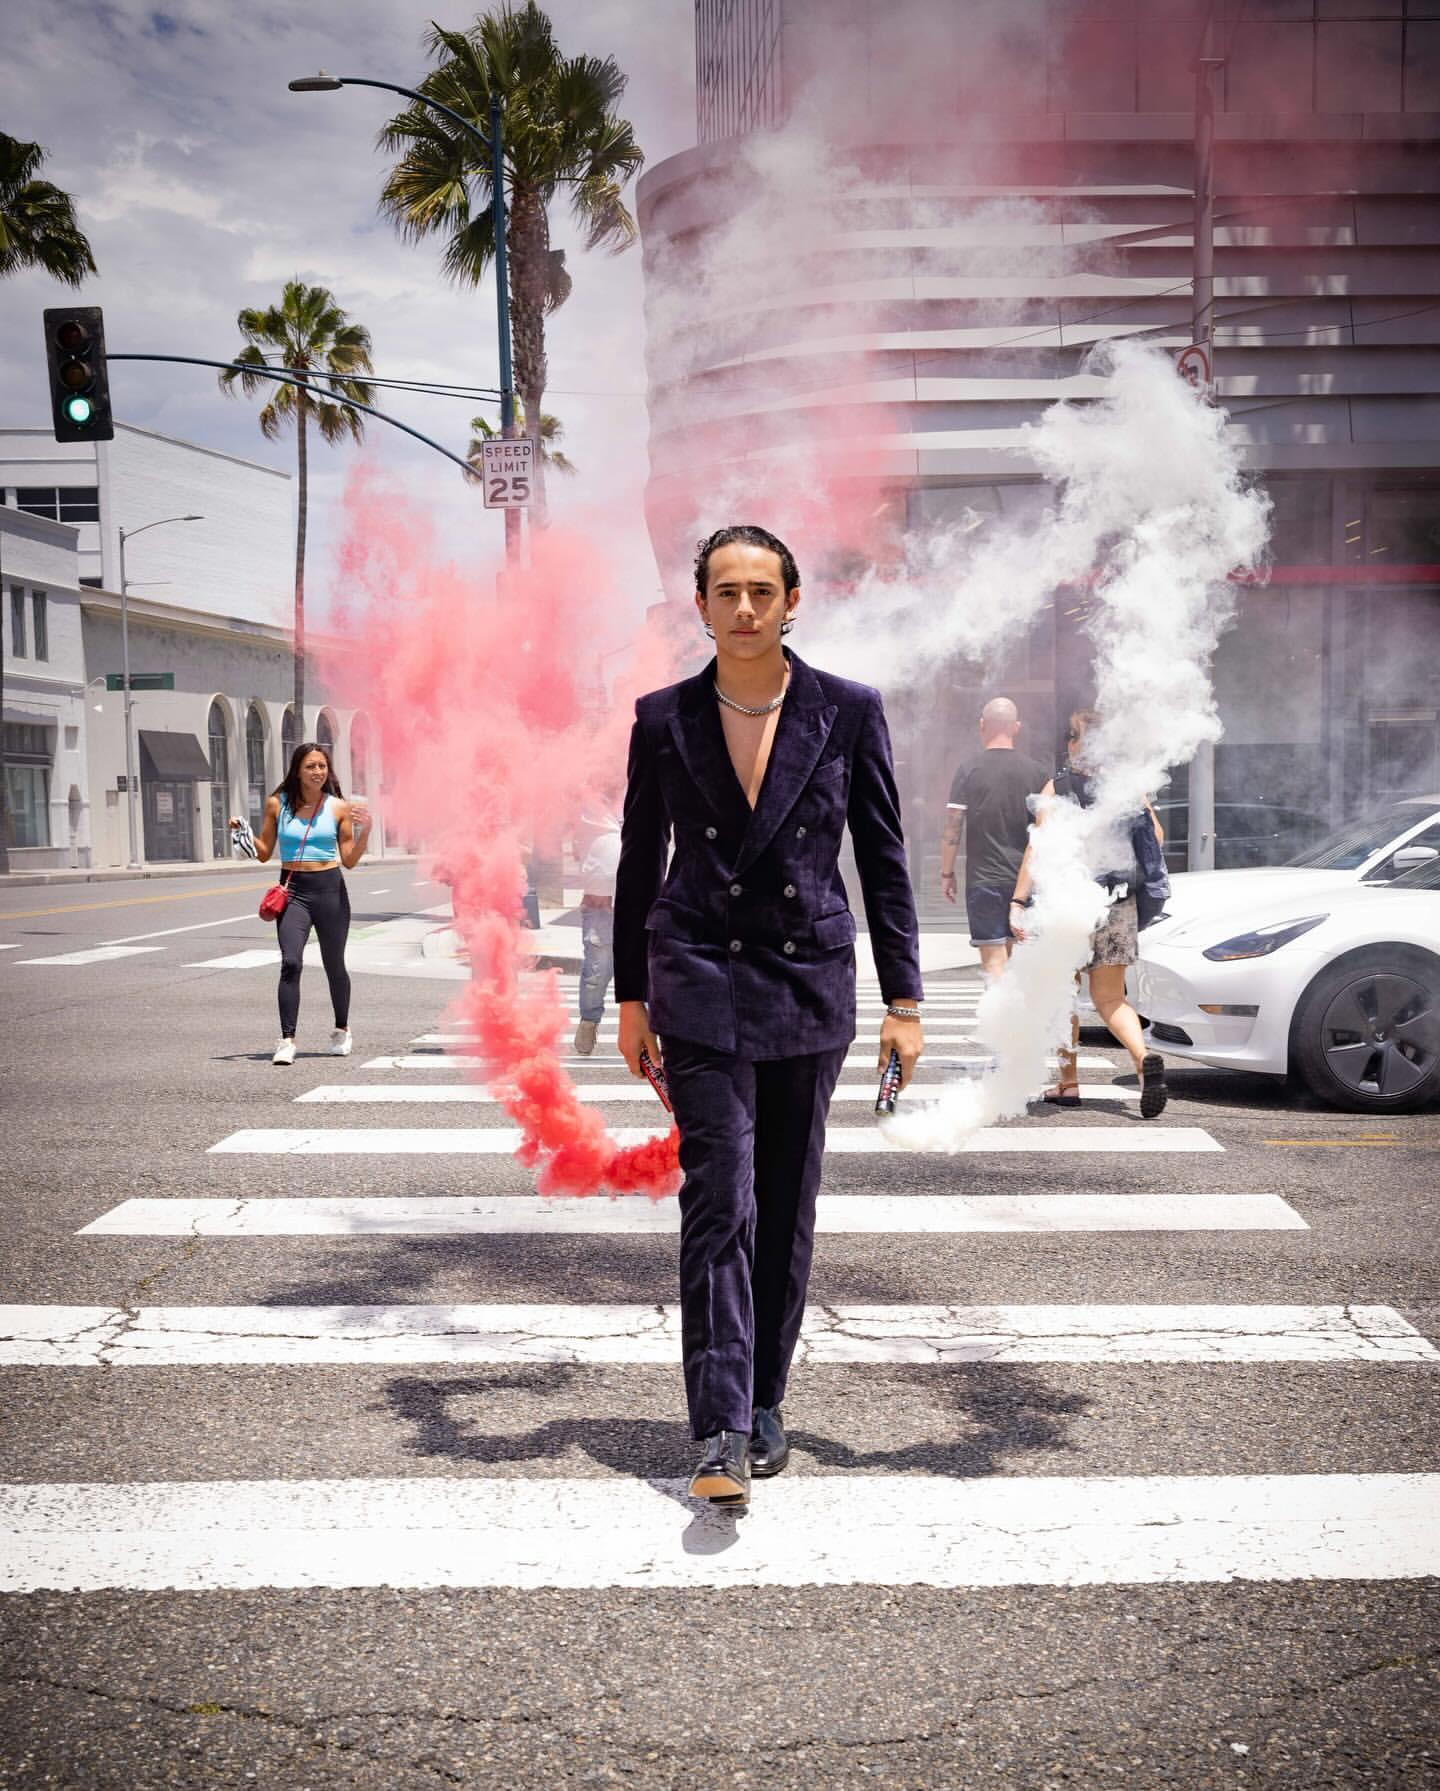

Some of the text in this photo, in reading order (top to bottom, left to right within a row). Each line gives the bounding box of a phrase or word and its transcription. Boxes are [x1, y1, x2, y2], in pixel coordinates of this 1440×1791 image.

[485, 446, 531, 457] SPEED
[491, 461, 528, 472] LIMIT
[489, 477, 530, 502] 25
